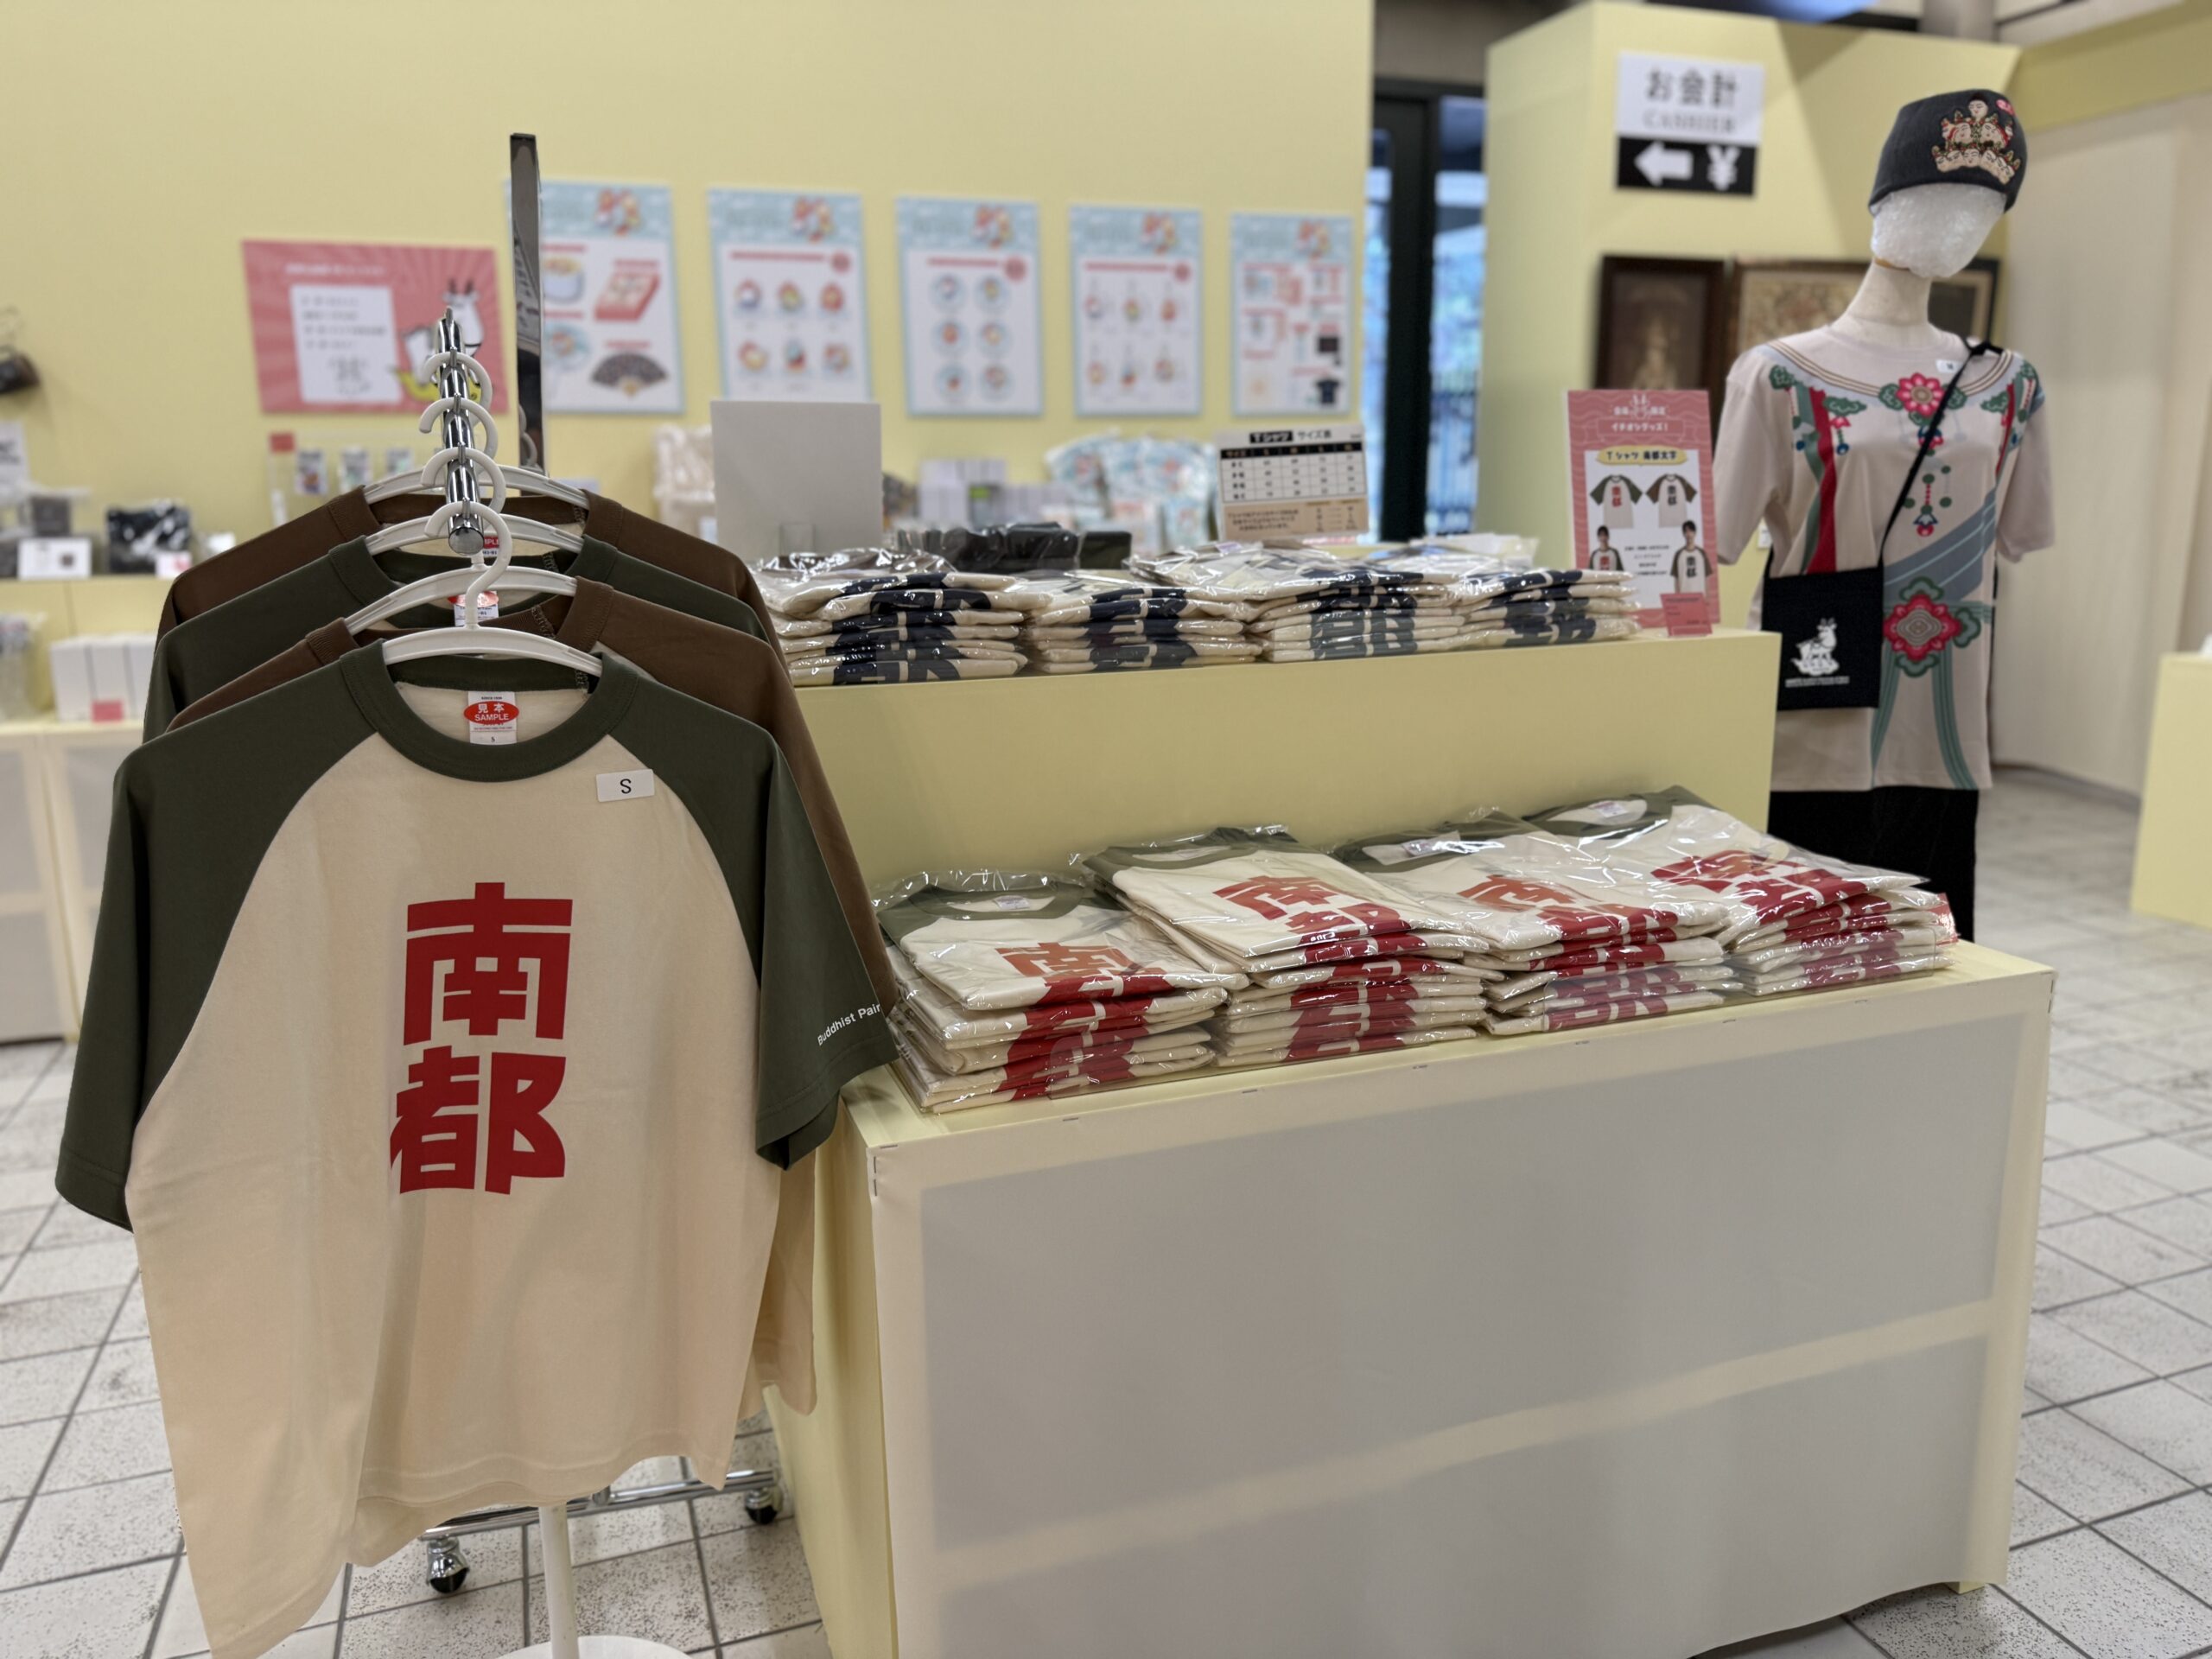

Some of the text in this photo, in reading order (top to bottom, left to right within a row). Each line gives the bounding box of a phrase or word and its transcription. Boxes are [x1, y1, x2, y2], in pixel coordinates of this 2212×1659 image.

[1645, 68, 1738, 108] お会計
[474, 713, 510, 722] SAMPLE
[478, 702, 505, 714] 見本
[620, 779, 632, 794] S
[390, 882, 573, 1195] 南都
[817, 1013, 856, 1046] Buddhist
